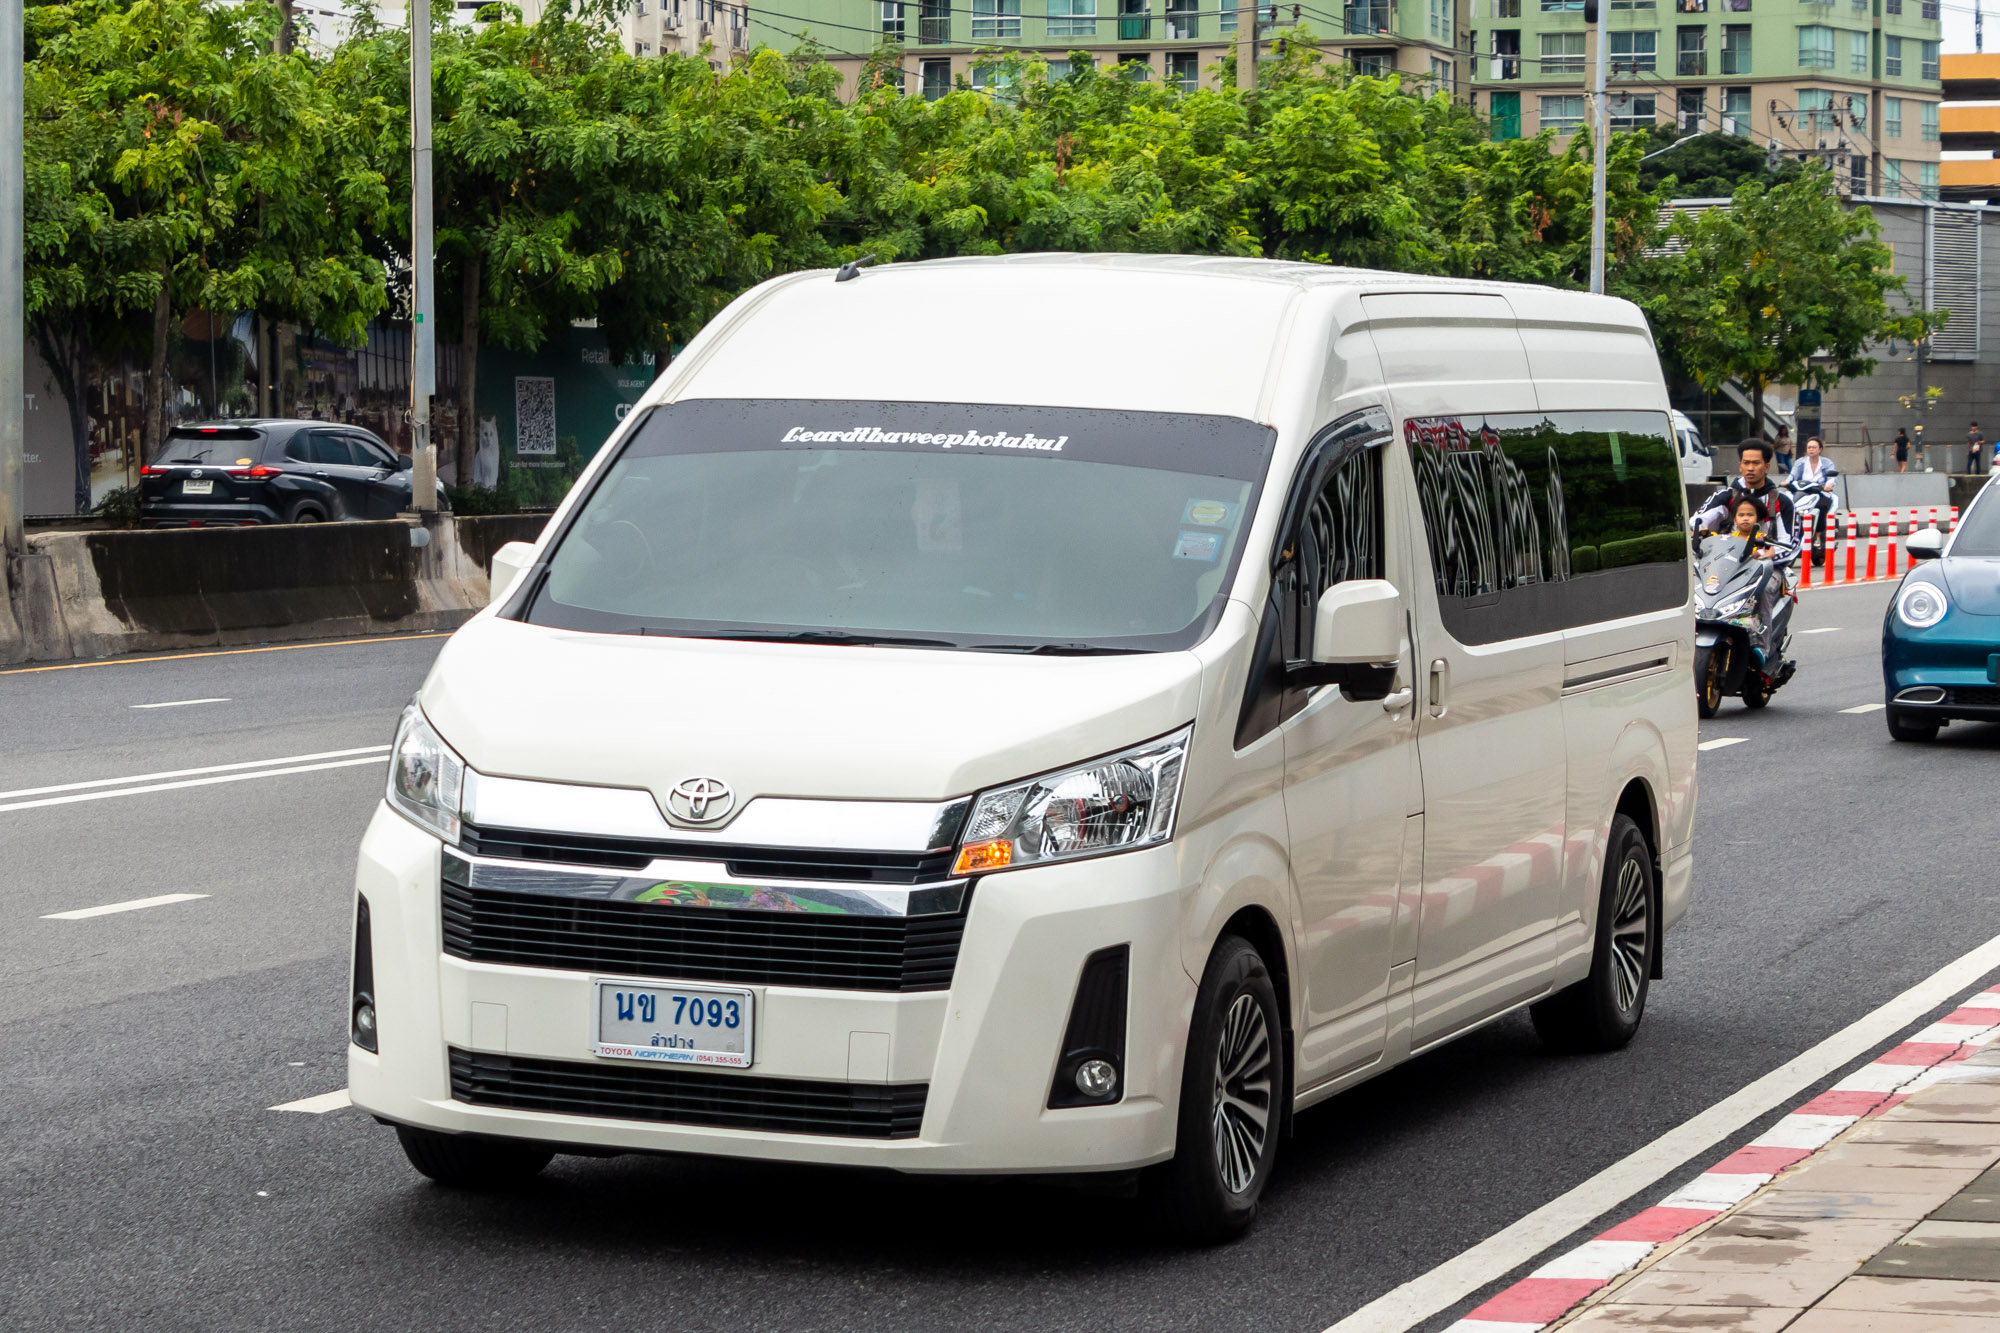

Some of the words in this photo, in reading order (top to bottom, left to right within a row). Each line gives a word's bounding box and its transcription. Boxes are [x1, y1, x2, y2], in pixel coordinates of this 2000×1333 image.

[581, 348, 609, 364] Retail
[672, 995, 740, 1029] 7093
[651, 1032, 694, 1049] ลำปาง
[600, 1046, 633, 1057] TOYOTA
[634, 1050, 694, 1062] NORTHERN
[696, 1054, 714, 1064] (054)
[715, 1055, 742, 1065] 355-555
